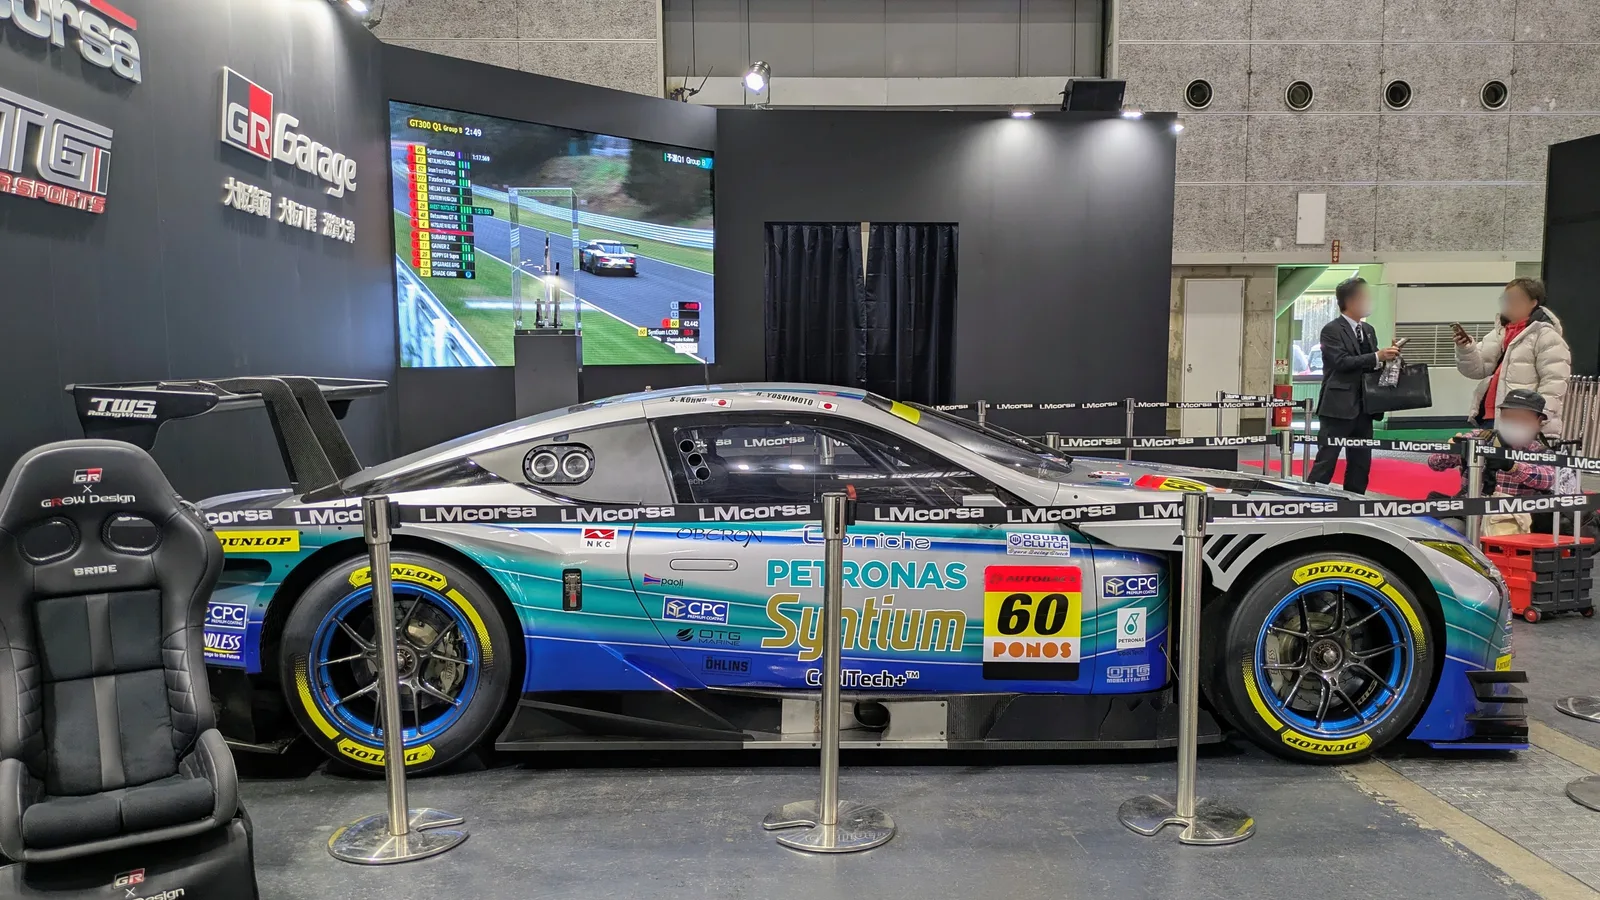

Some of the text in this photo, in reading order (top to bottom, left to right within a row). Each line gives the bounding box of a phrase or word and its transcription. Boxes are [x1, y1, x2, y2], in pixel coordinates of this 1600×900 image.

[409, 118, 431, 129] GT300
[432, 122, 442, 132] Q1
[443, 125, 458, 134] Group
[465, 127, 482, 137] 2:49
[273, 112, 357, 198] Garage
[686, 156, 701, 166] Group
[91, 398, 157, 414] TWS
[767, 392, 814, 406] YOSHIMOTO
[1040, 402, 1075, 410] LMcorsa
[1082, 401, 1117, 409] LMcorsa
[744, 436, 804, 448] LMcorsa
[1061, 437, 1121, 447] LMcorsa
[1133, 436, 1194, 447] LMcorsa
[1206, 434, 1267, 446] LMcorsa
[1328, 437, 1381, 448] LMcorsa
[1391, 440, 1451, 451] LMcorsa
[1505, 450, 1556, 462] LMcorsa
[90, 494, 136, 504] Design
[420, 507, 537, 522] LMcorsa
[561, 506, 675, 523] LMcorsa
[699, 504, 811, 522] LMcorsa
[874, 506, 985, 522] LMcorsa
[1007, 503, 1116, 523] LMcorsa
[1232, 500, 1338, 518] LMcorsa
[1359, 499, 1464, 518] LMcorsa
[1485, 494, 1587, 514] LMcorsa
[587, 540, 611, 548] NKC
[1023, 540, 1069, 549] CLUTCH
[73, 564, 117, 577] BRIDE
[1307, 564, 1379, 580] DUNLOP
[1126, 577, 1156, 591] CPC
[211, 605, 244, 621] CPC
[687, 602, 726, 617] CPC
[997, 593, 1069, 636] 60
[761, 592, 967, 661] Syntium
[204, 632, 242, 650] NDLESS
[699, 629, 741, 641] OTG
[699, 638, 740, 647] MARINE
[993, 641, 1072, 659] PONOS
[706, 657, 748, 672] ÖHLINS
[1286, 737, 1358, 752] DUNLOP
